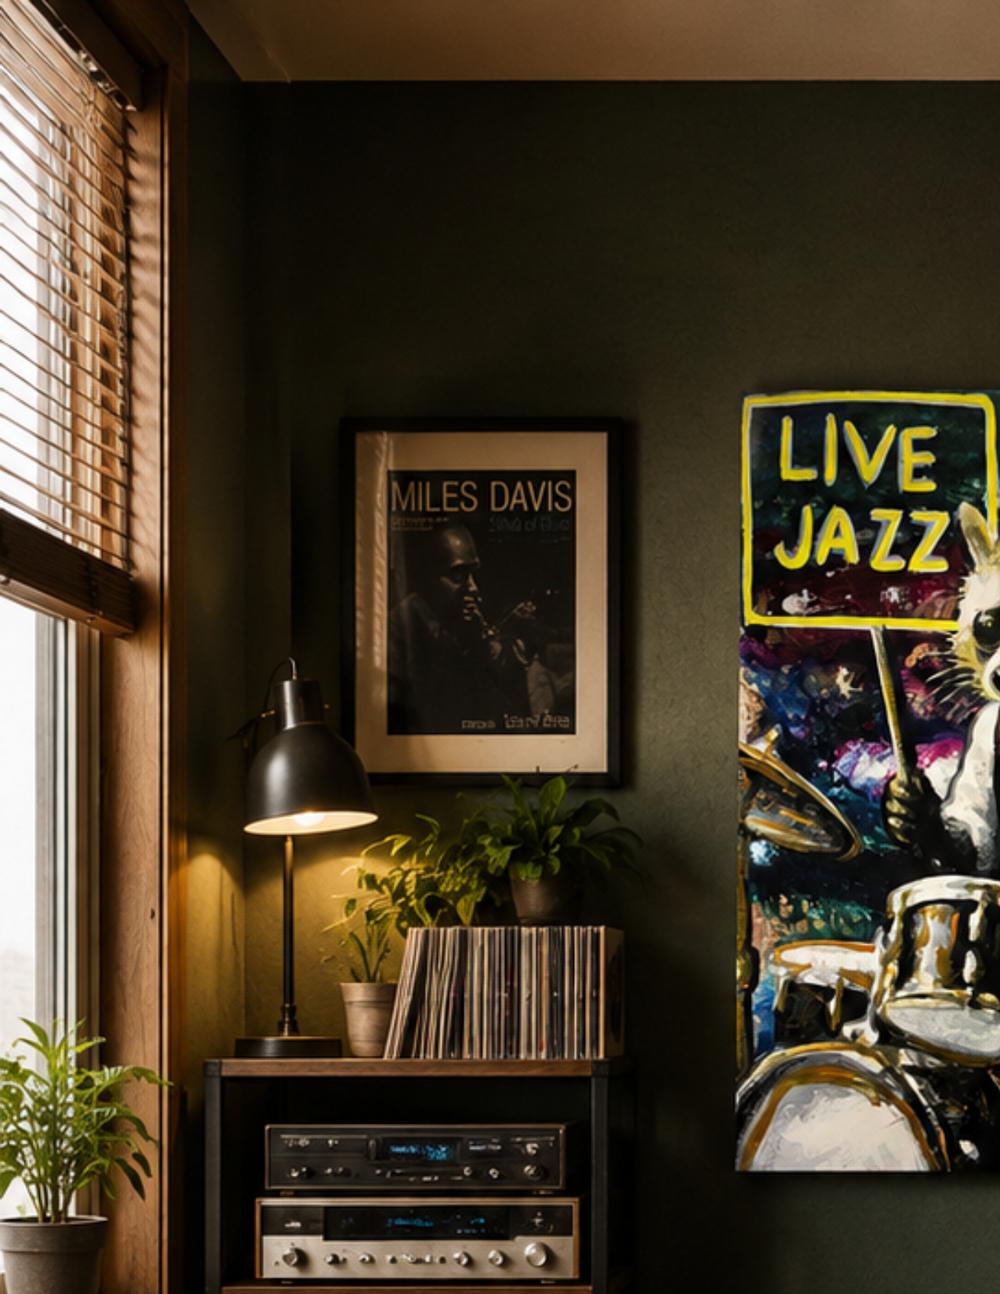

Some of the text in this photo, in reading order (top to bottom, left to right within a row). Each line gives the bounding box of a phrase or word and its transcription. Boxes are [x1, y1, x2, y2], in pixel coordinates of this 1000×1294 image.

[780, 413, 938, 493] LIVE
[391, 480, 573, 512] MILES DAVIS
[774, 504, 951, 573] JAZZ
